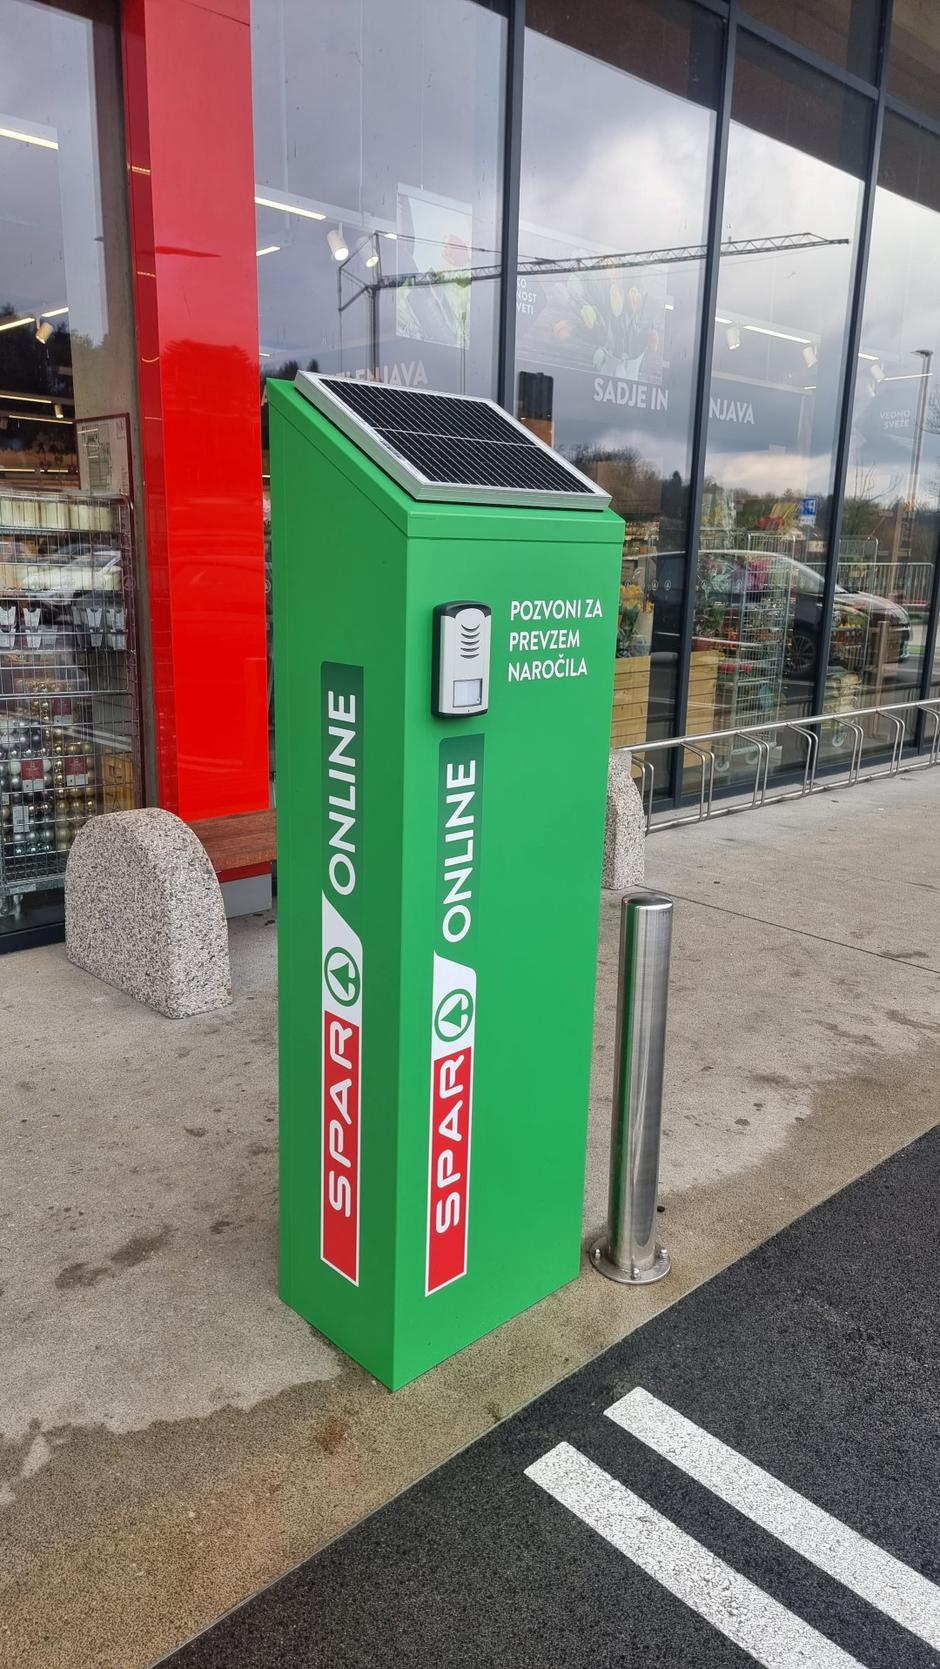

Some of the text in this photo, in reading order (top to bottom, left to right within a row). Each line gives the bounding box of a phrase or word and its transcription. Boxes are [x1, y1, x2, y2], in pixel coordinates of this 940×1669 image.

[593, 377, 669, 412] SADJE IN
[510, 599, 603, 621] POZVONI ZA
[509, 629, 580, 652] PREVZEM
[508, 653, 588, 682] NAROČILA
[328, 690, 356, 1218] SPAR ONLINE
[435, 759, 476, 1234] SPAR ONLINE
